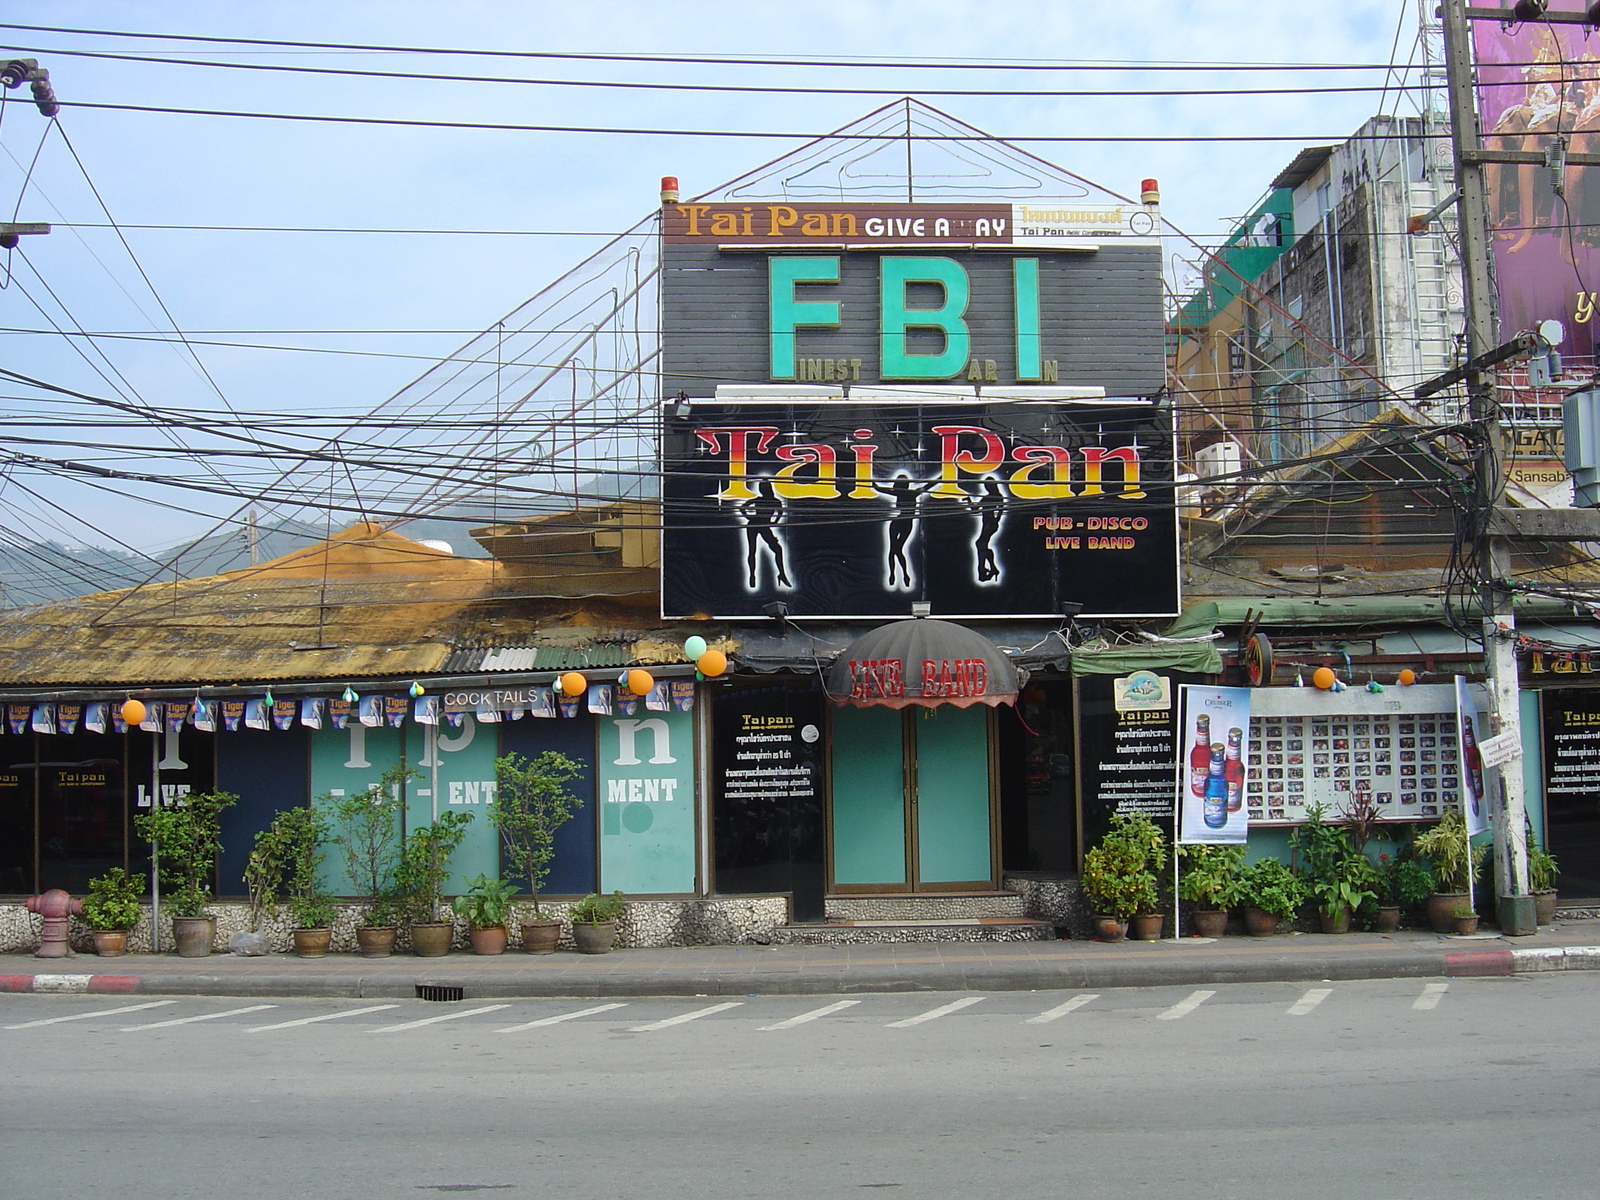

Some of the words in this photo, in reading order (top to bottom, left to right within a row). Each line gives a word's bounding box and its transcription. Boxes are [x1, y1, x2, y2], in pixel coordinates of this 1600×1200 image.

[676, 205, 754, 236] Tai
[767, 205, 859, 236] Pan
[865, 217, 925, 237] GIVE
[1021, 226, 1039, 236] Tai
[1043, 226, 1065, 236] Pan
[1574, 291, 1600, 323] y
[694, 426, 882, 500] Tai
[931, 425, 1148, 500] Pan
[1033, 516, 1073, 530] PUB
[1087, 516, 1149, 531] DISCO
[1045, 536, 1081, 550] LIVE
[1087, 536, 1136, 550] BAND
[848, 658, 905, 699] LIVE
[920, 658, 988, 698] BAND
[672, 682, 694, 691] Tiger
[167, 702, 188, 712] Tiger
[222, 701, 244, 711] Tiger
[274, 700, 296, 709] Tiger
[330, 698, 351, 708] Tiger
[386, 697, 408, 707] Tiger
[9, 704, 31, 714] Tiger
[60, 704, 80, 714] Tiger
[742, 715, 793, 725] Taipan
[1118, 710, 1170, 720] Taipan
[0, 774, 18, 782] an
[58, 771, 105, 782] Taipan
[137, 784, 191, 807] LVE
[449, 781, 498, 804] ENT
[607, 778, 678, 803] MENT
